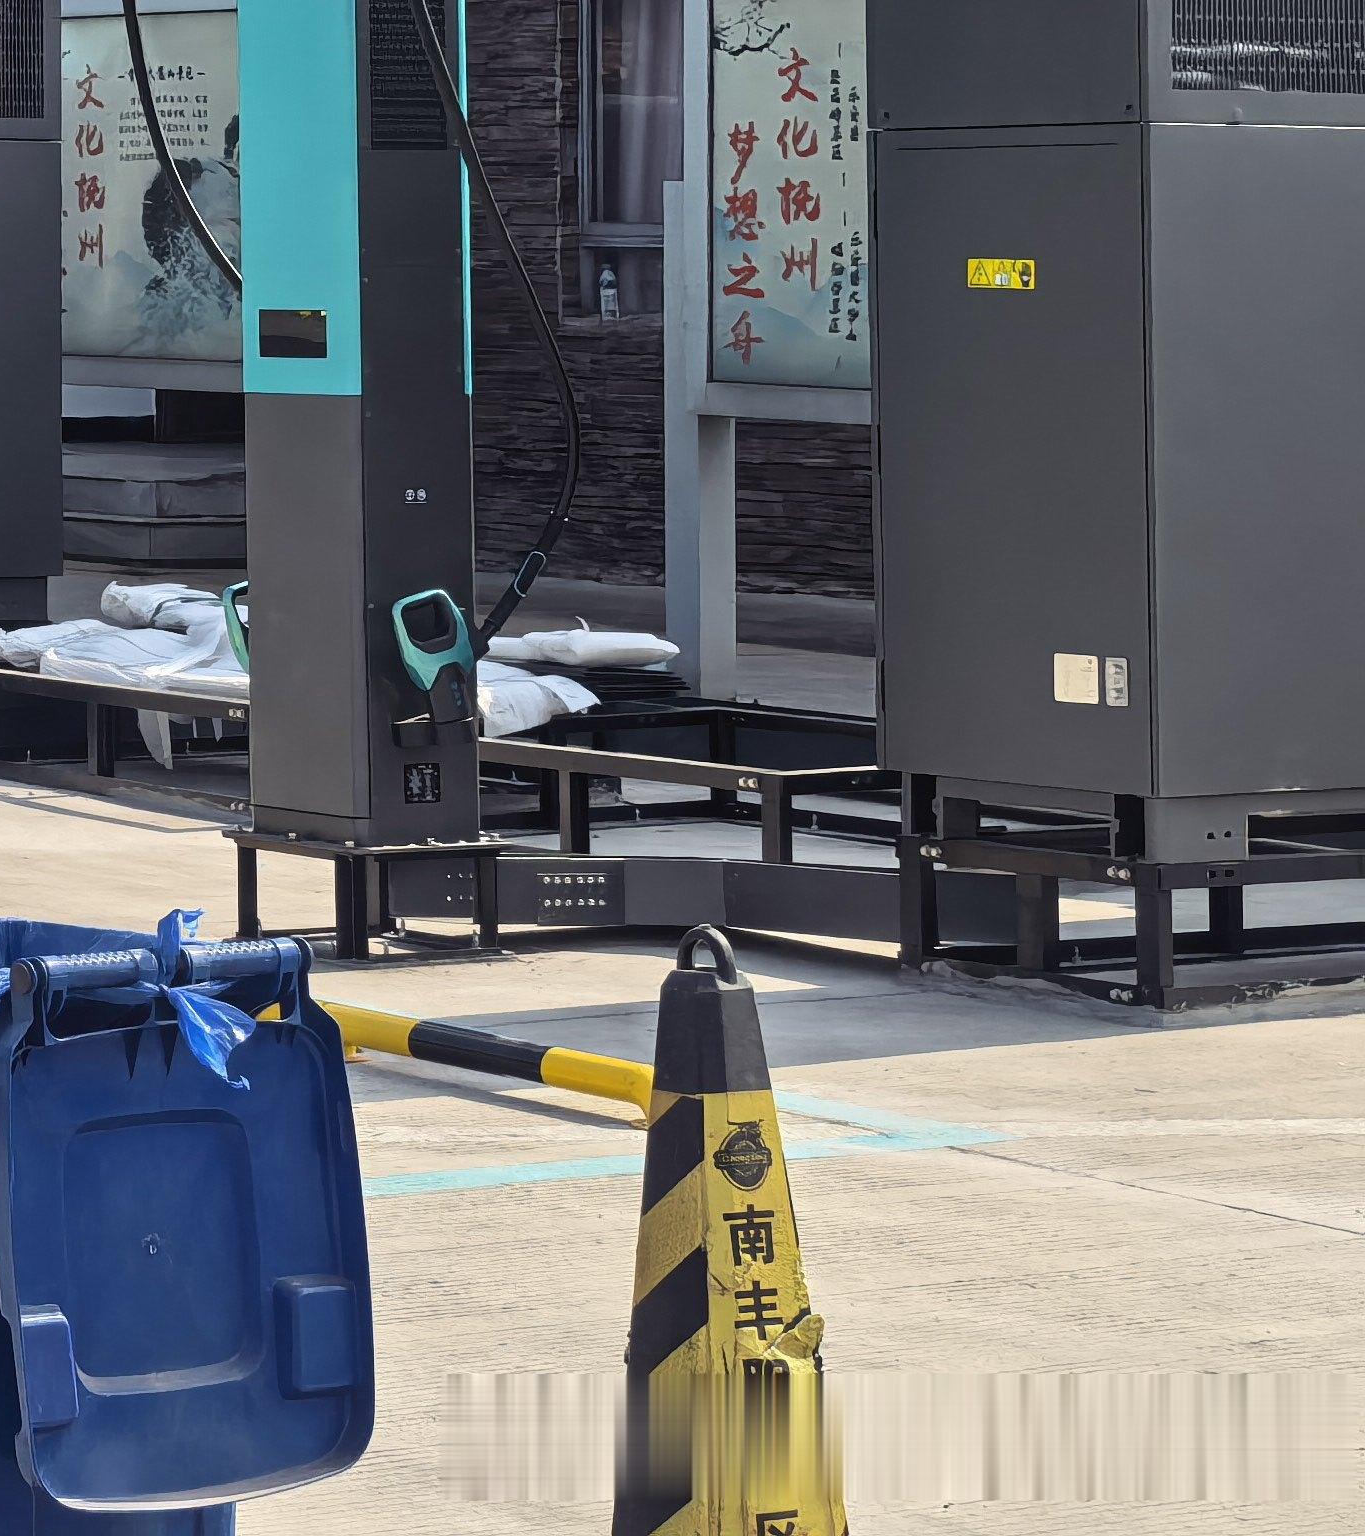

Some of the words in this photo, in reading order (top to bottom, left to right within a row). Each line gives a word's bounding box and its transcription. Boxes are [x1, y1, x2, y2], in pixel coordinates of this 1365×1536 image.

[74, 64, 106, 269] 文化抚州
[776, 47, 821, 292] 文化抚州
